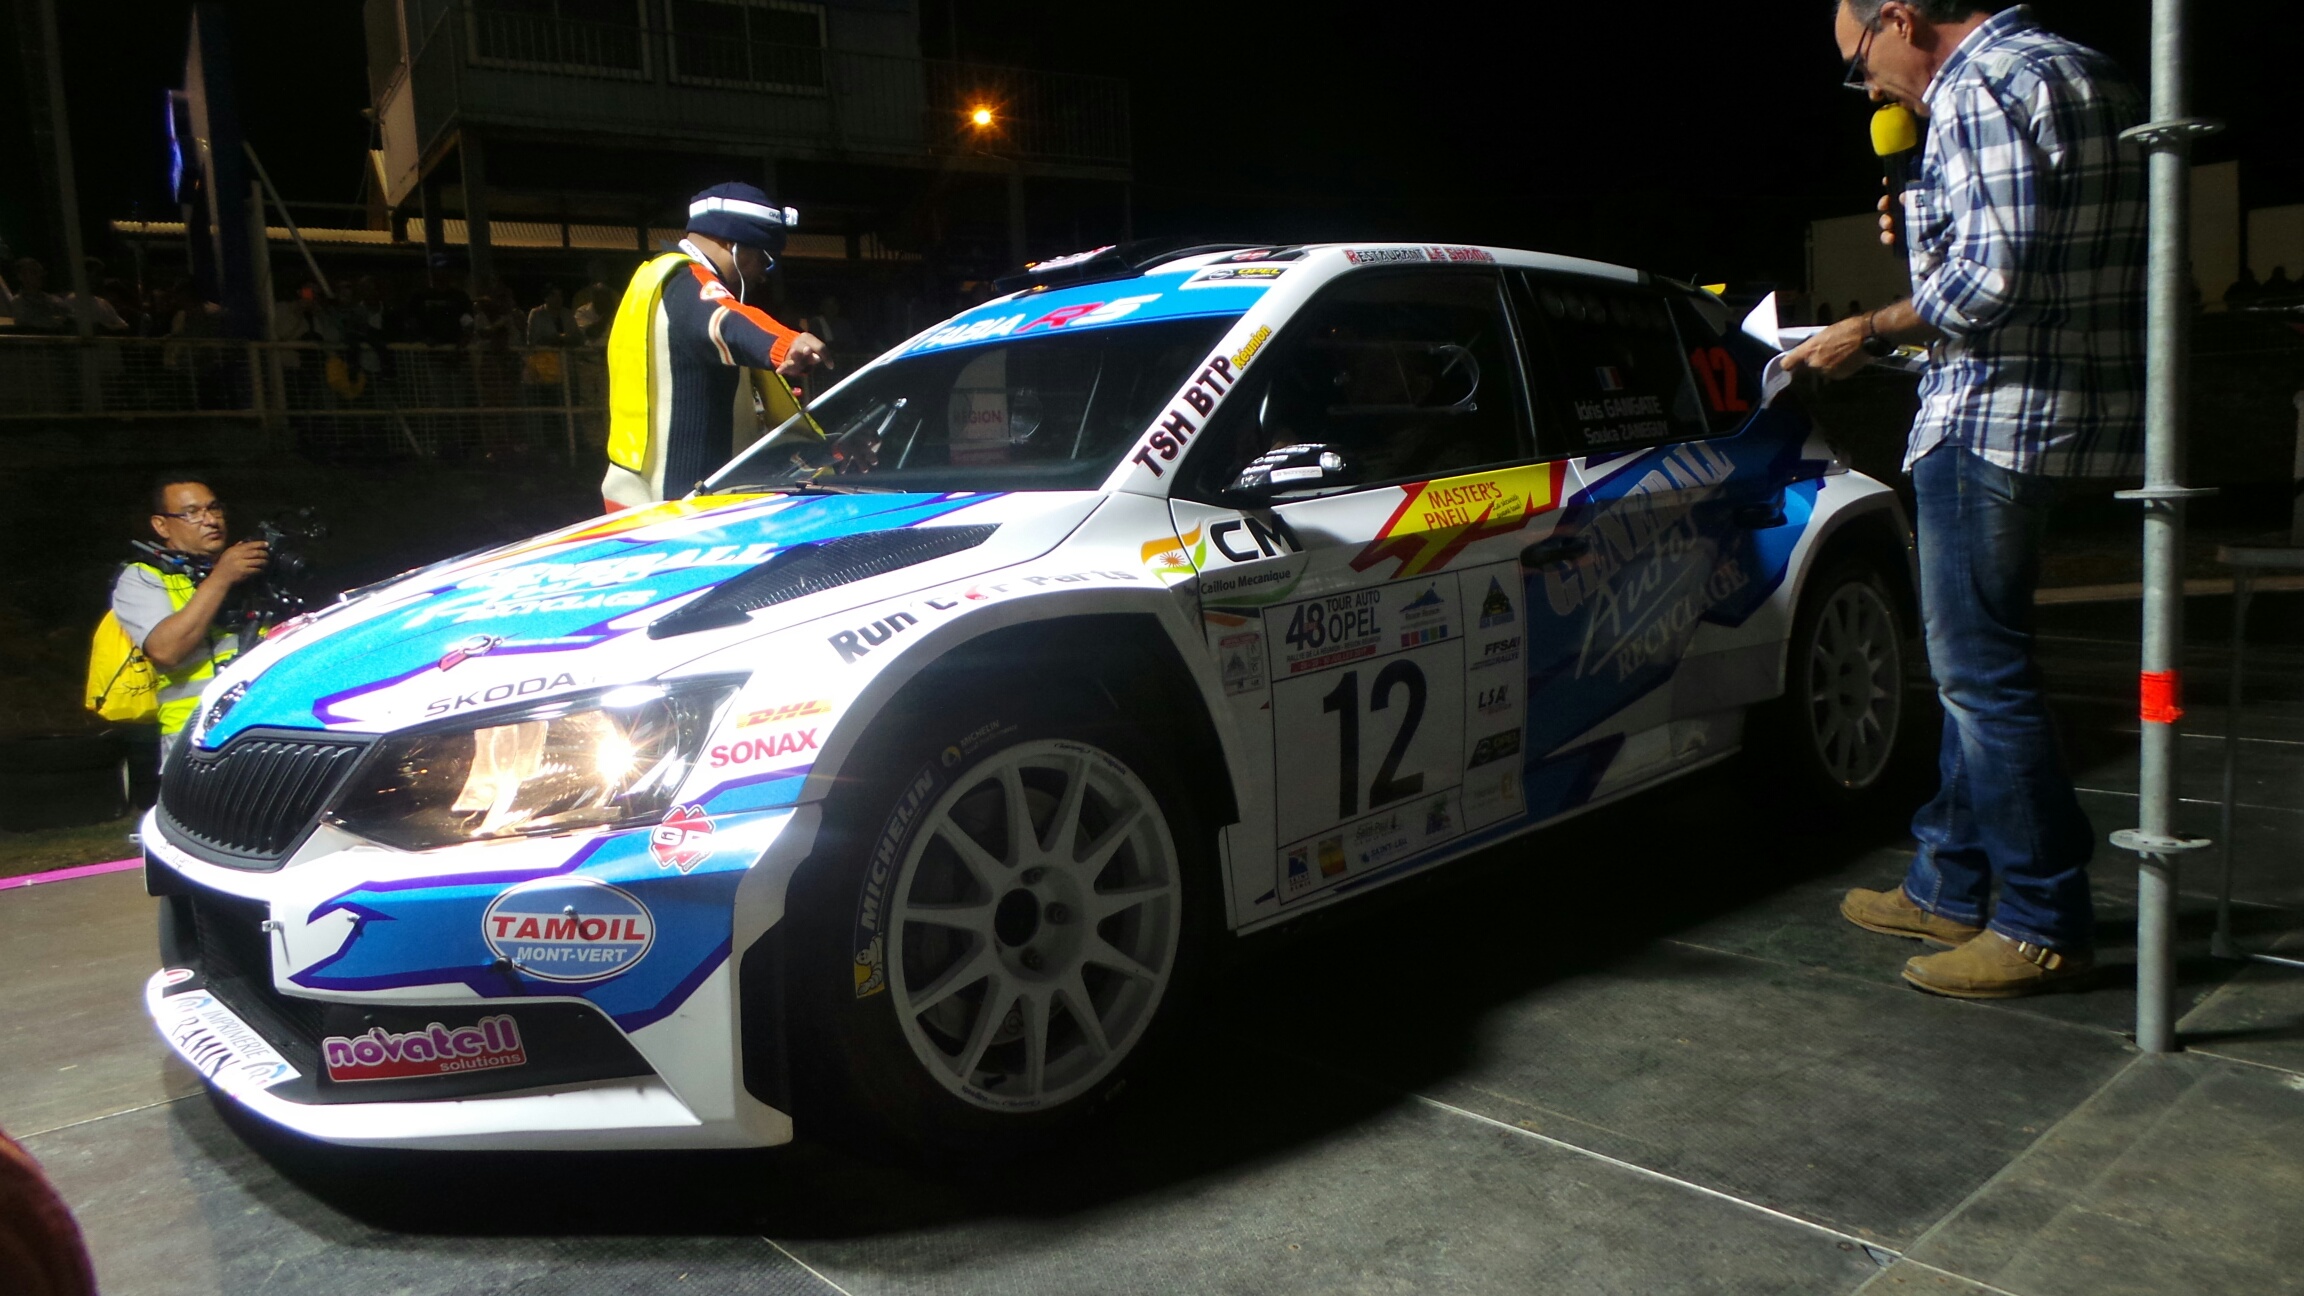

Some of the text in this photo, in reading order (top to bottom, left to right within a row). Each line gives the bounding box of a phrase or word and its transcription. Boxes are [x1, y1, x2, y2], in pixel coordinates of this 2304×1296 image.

[922, 293, 1163, 349] FABIA R5
[1132, 409, 1197, 478] TSH
[1182, 354, 1236, 418] BTP
[1230, 324, 1273, 371] Réunion
[1690, 346, 1749, 412] 12
[1423, 506, 1470, 531] PNEU
[1426, 481, 1503, 510] MASTER'S
[1209, 513, 1304, 562] CM
[1201, 579, 1236, 595] Caillou
[1238, 569, 1291, 588] Mecanique
[1326, 591, 1381, 613] TOUR AUTO
[827, 611, 919, 665] Run
[1021, 569, 1139, 587] Parts
[1286, 602, 1326, 651] 48
[1329, 607, 1381, 643] OPEL
[1617, 557, 1749, 683] RECYCLAGE
[424, 672, 577, 718] SKODA
[746, 700, 822, 727] DHL
[710, 727, 819, 769] SONAX
[1322, 658, 1427, 820] 12
[861, 768, 935, 932] MICHELIN
[492, 915, 646, 941] TAMOIL
[516, 947, 628, 964] MONT-VERT
[201, 1009, 271, 1060] IMPRIMERIE
[325, 1016, 518, 1067] novatell
[440, 1053, 522, 1072] solutions
